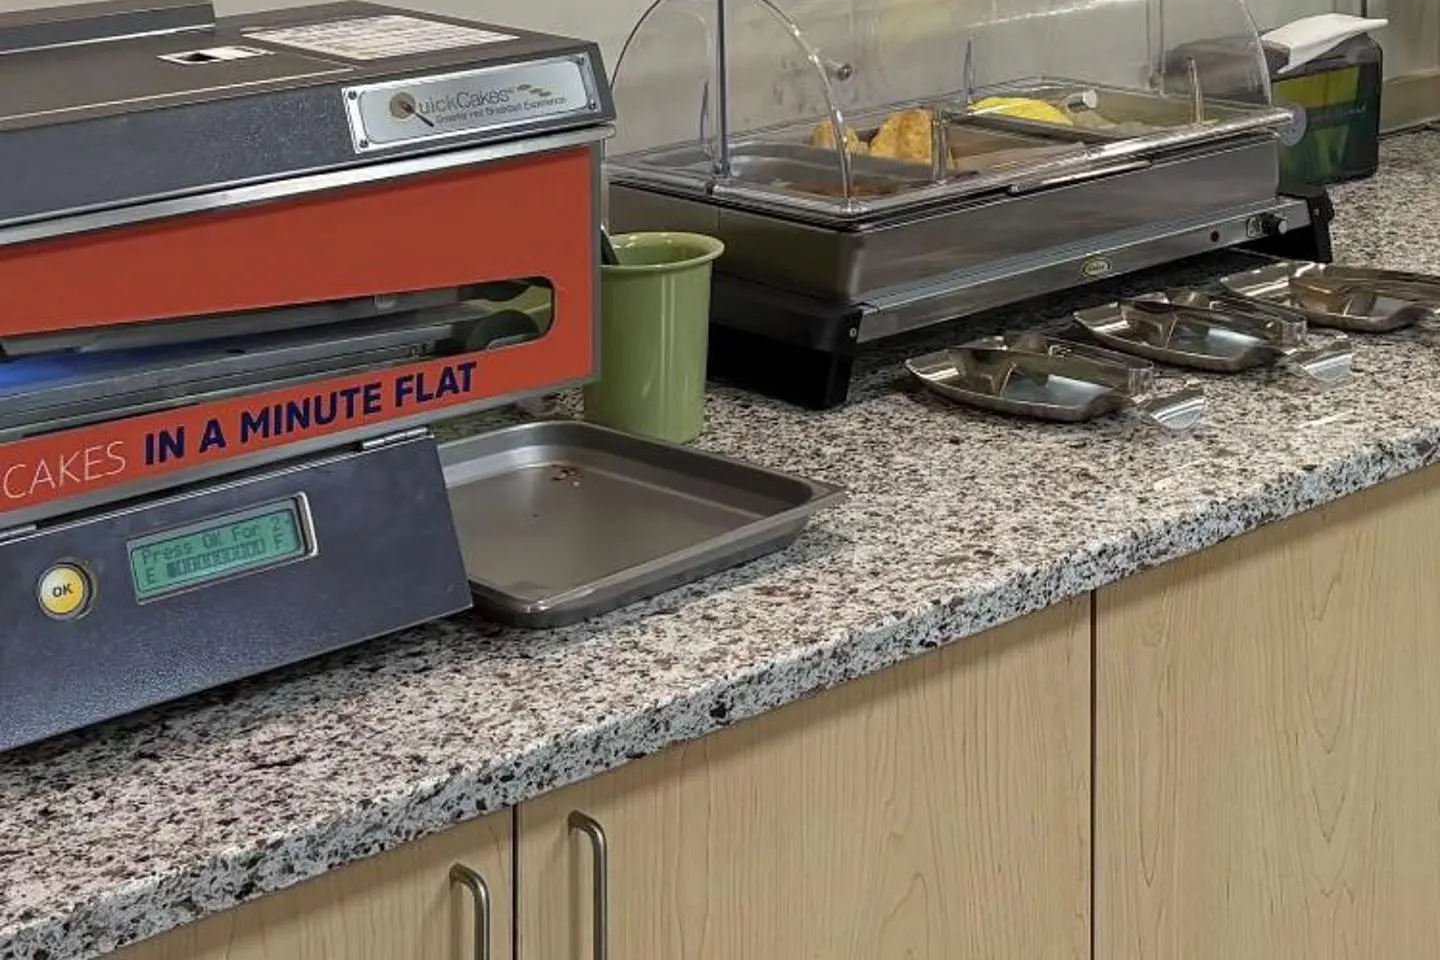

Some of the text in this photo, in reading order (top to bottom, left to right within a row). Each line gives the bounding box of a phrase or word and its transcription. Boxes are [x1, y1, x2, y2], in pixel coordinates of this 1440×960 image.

[3, 361, 478, 499] CAKES IN A MINUTE FLAT
[141, 543, 193, 565] Press
[52, 582, 74, 599] OK
